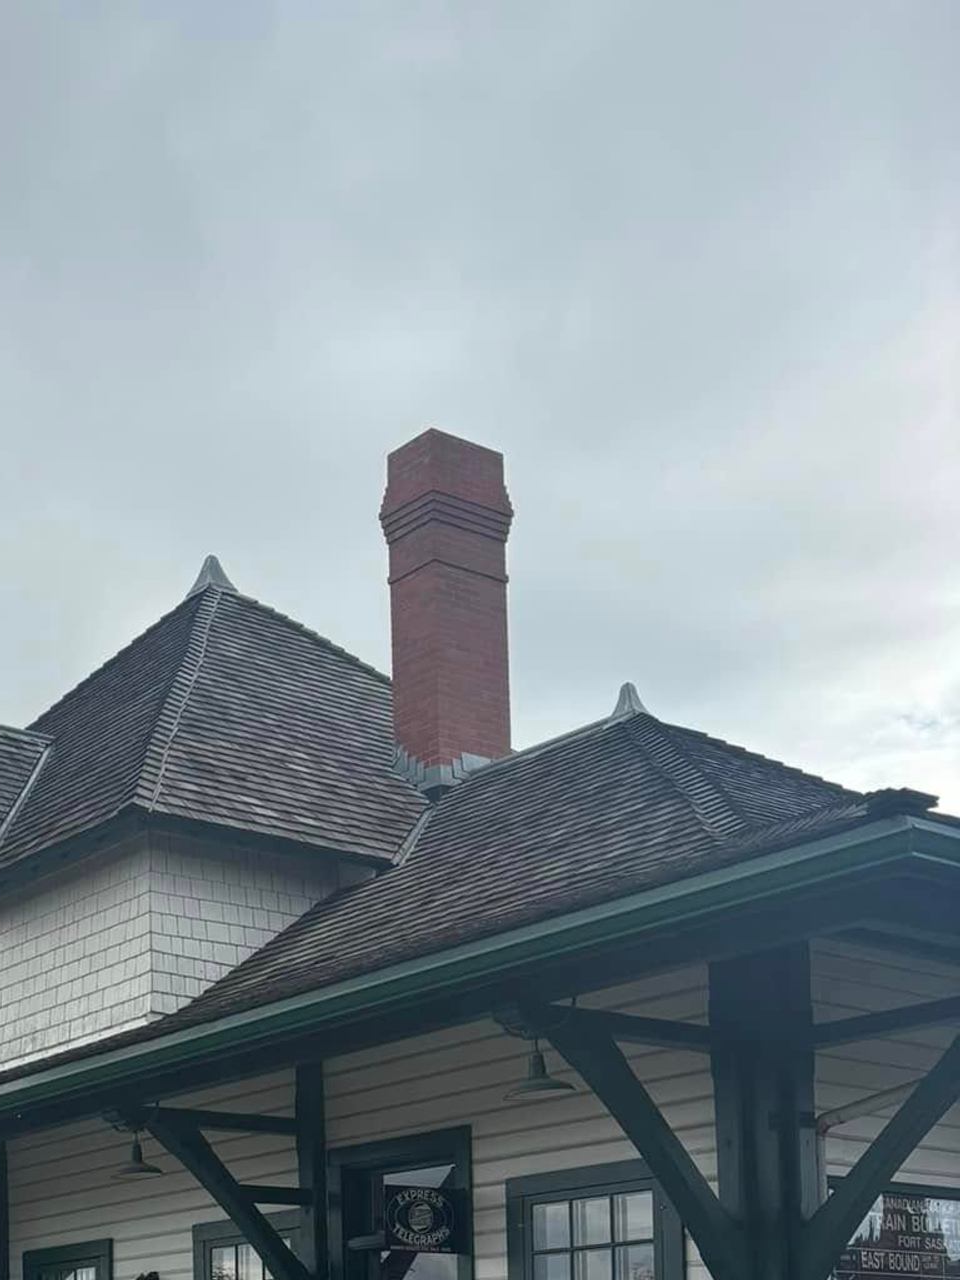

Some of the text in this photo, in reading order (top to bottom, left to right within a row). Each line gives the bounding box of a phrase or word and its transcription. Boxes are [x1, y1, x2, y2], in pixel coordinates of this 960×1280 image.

[396, 1189, 444, 1208] EXPRESS
[897, 1235, 921, 1249] FORT
[861, 1251, 885, 1270] EAST
[888, 1253, 920, 1272] BOUND
